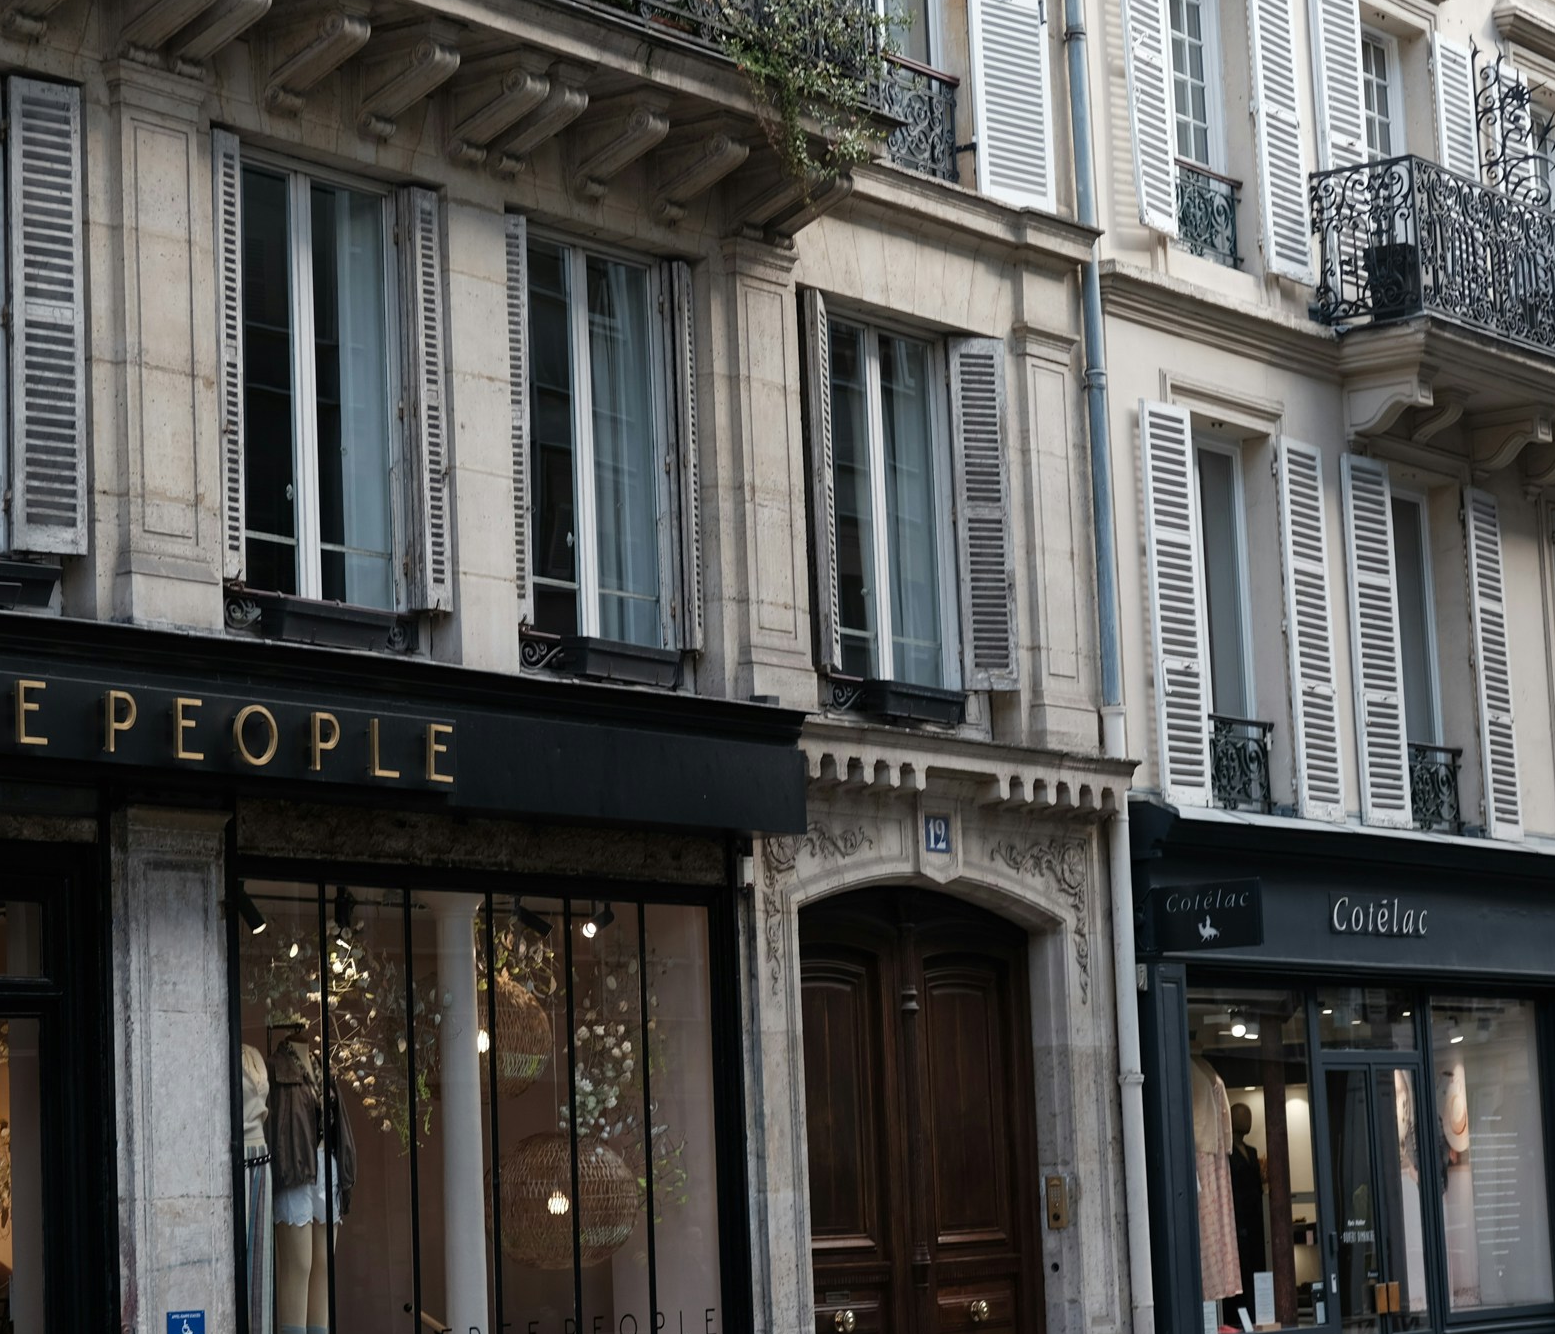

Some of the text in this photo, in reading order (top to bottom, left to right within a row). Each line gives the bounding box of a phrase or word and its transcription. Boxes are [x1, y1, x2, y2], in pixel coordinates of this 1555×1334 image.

[103, 688, 455, 784] PEOPLE
[928, 818, 947, 850] 12
[1165, 888, 1250, 914] Cotélac
[1332, 896, 1429, 935] Cotélac
